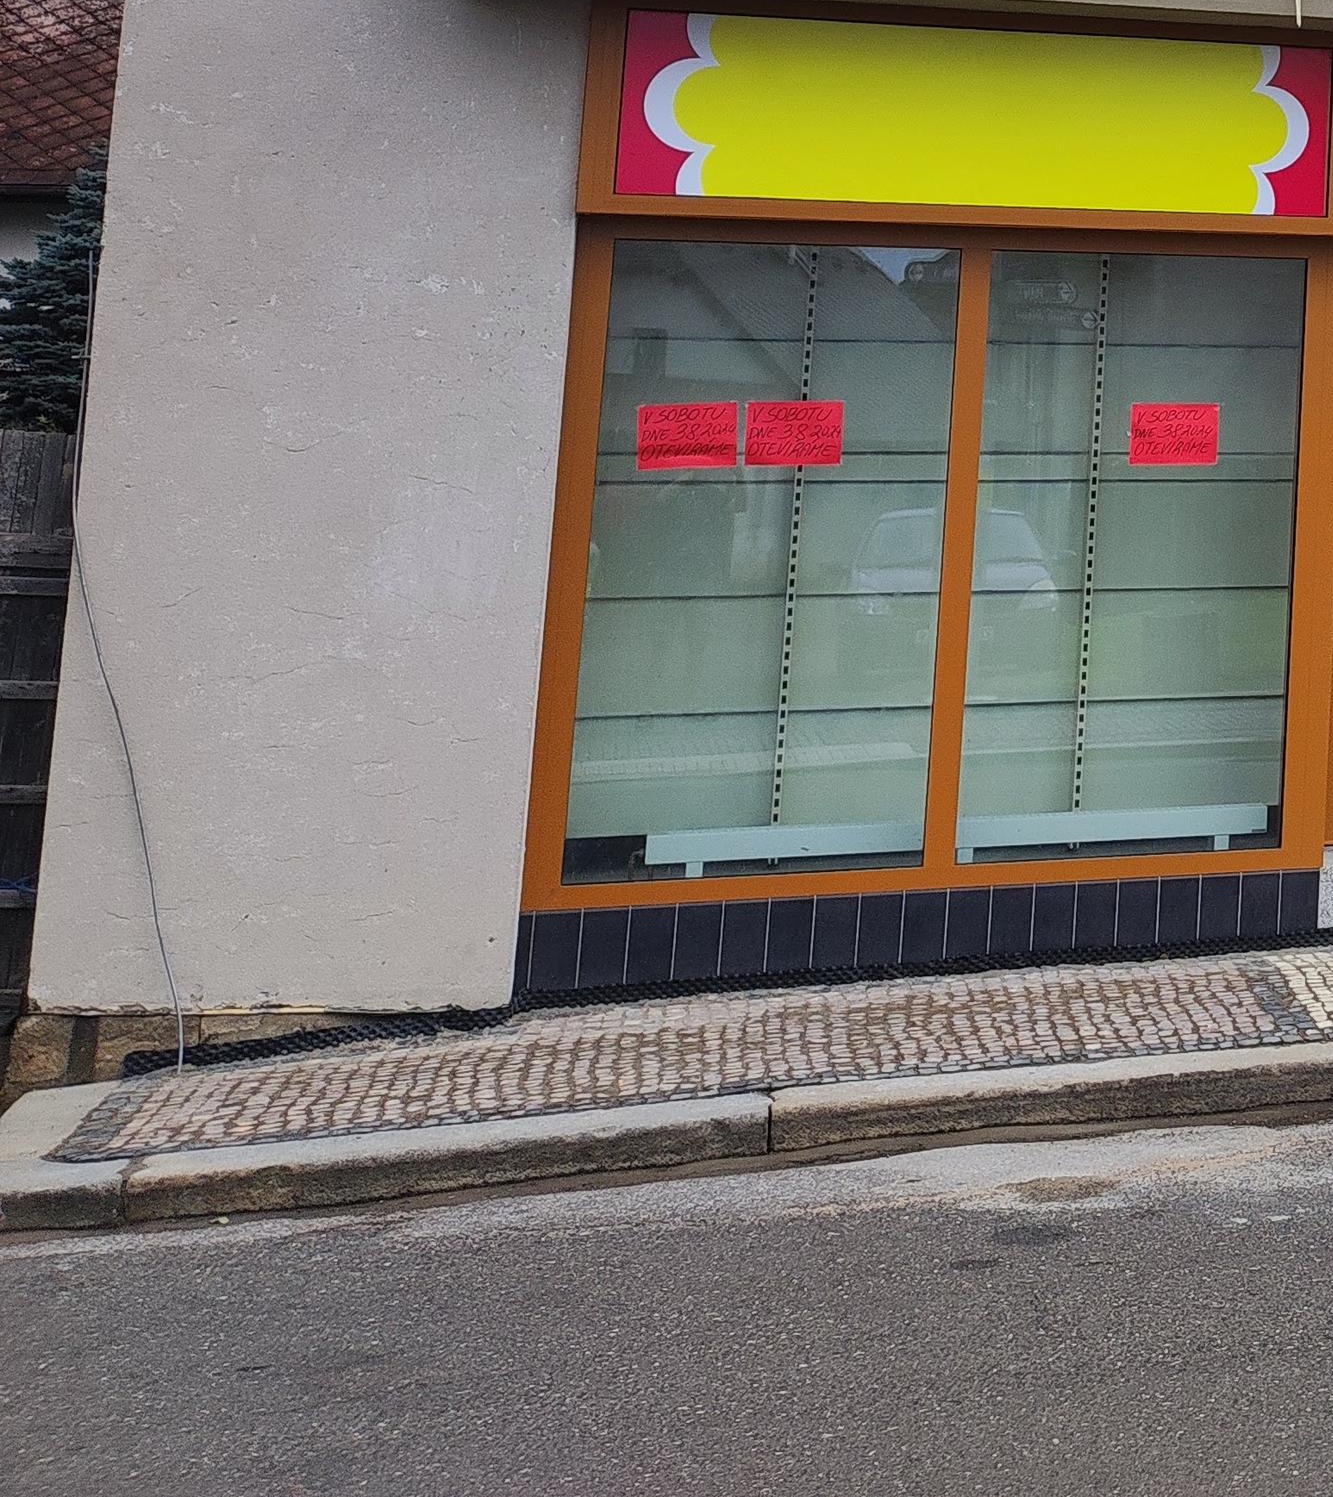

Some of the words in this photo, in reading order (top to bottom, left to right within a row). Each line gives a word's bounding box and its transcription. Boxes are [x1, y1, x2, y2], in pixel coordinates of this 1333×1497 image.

[652, 407, 727, 424] SOBOTU
[762, 406, 833, 423] SOBOTU
[1146, 409, 1206, 423] SOBOTU
[641, 428, 670, 443] DNE
[749, 426, 778, 440] DNE
[1134, 427, 1157, 440] DNE
